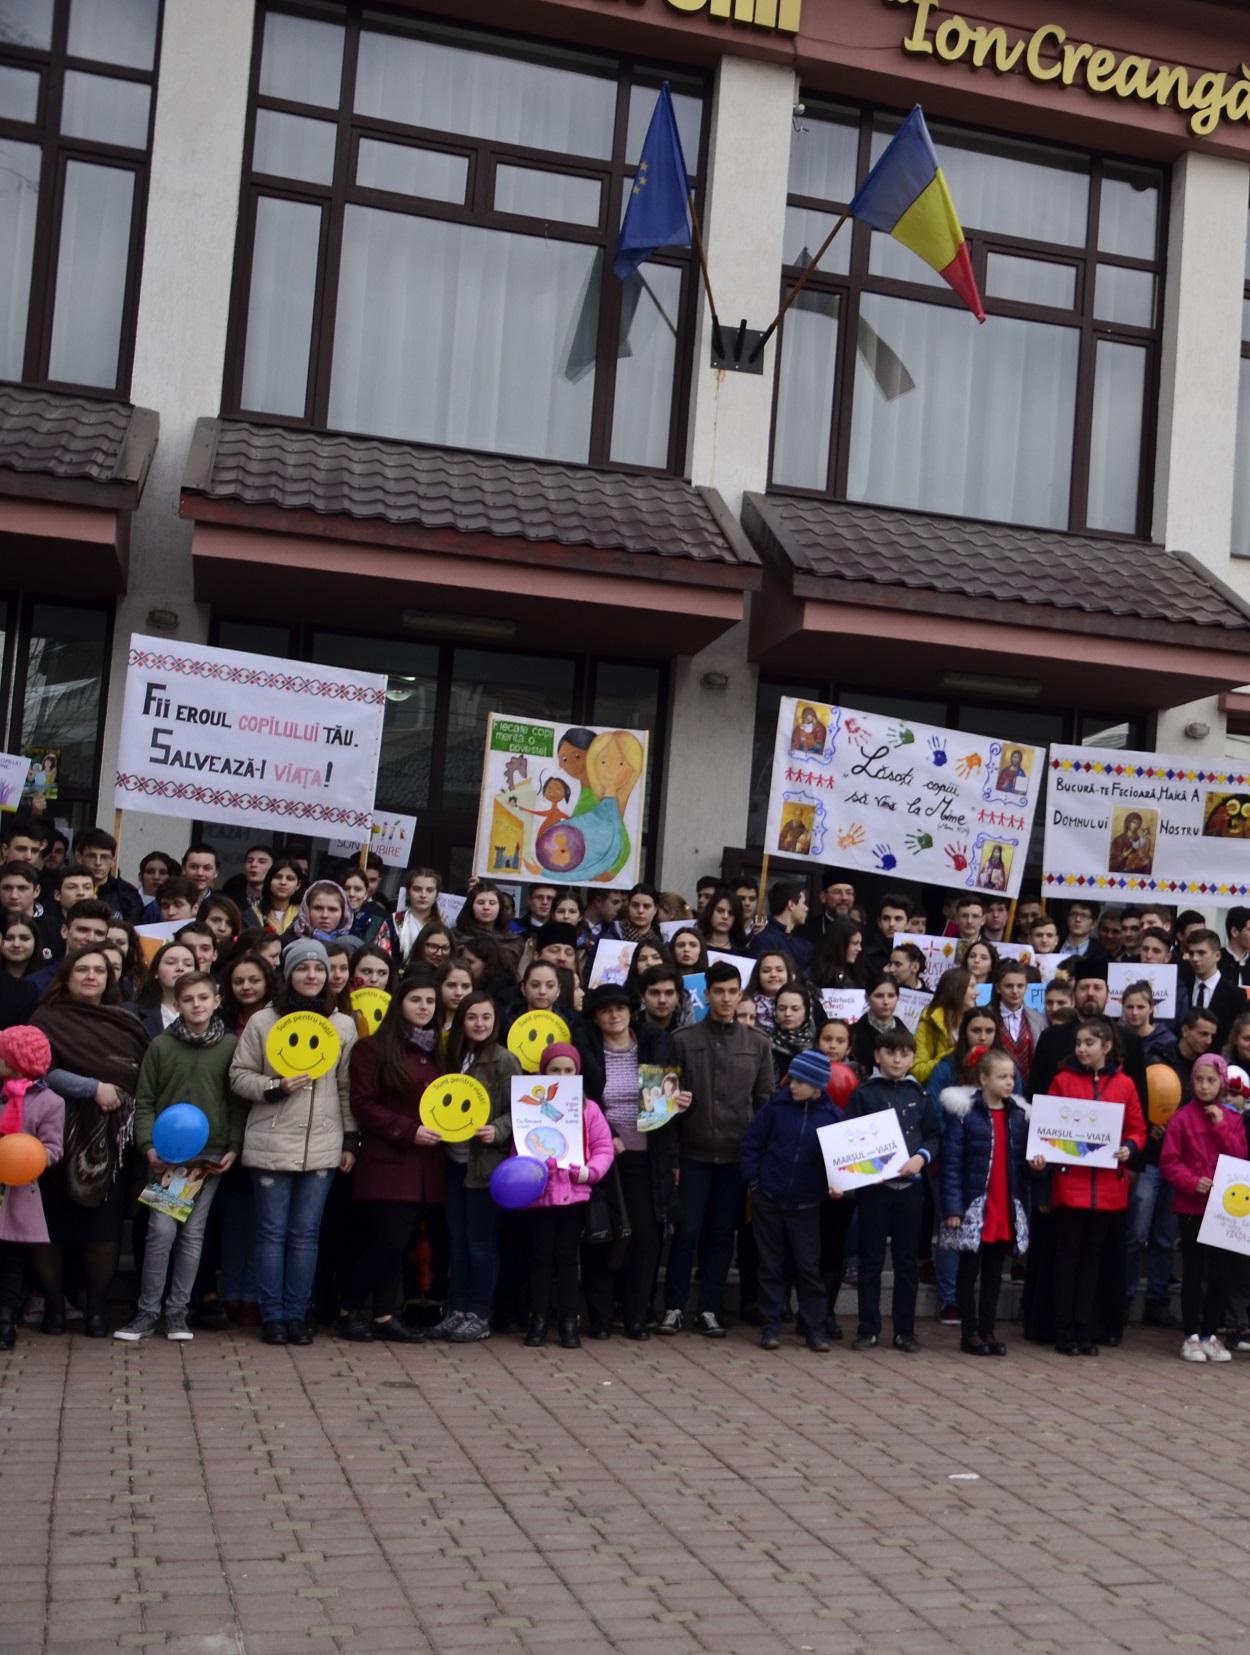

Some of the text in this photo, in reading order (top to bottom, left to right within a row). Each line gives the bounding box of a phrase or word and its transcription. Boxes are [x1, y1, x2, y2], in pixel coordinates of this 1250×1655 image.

[886, 0, 1025, 71] Ion
[175, 704, 232, 728] EROUL
[323, 725, 358, 747] TĂU.
[149, 727, 267, 779] SALVEAZĂ-I
[1159, 819, 1199, 836] NOSTRU
[336, 839, 360, 850] SUN
[293, 1014, 318, 1023] pentru
